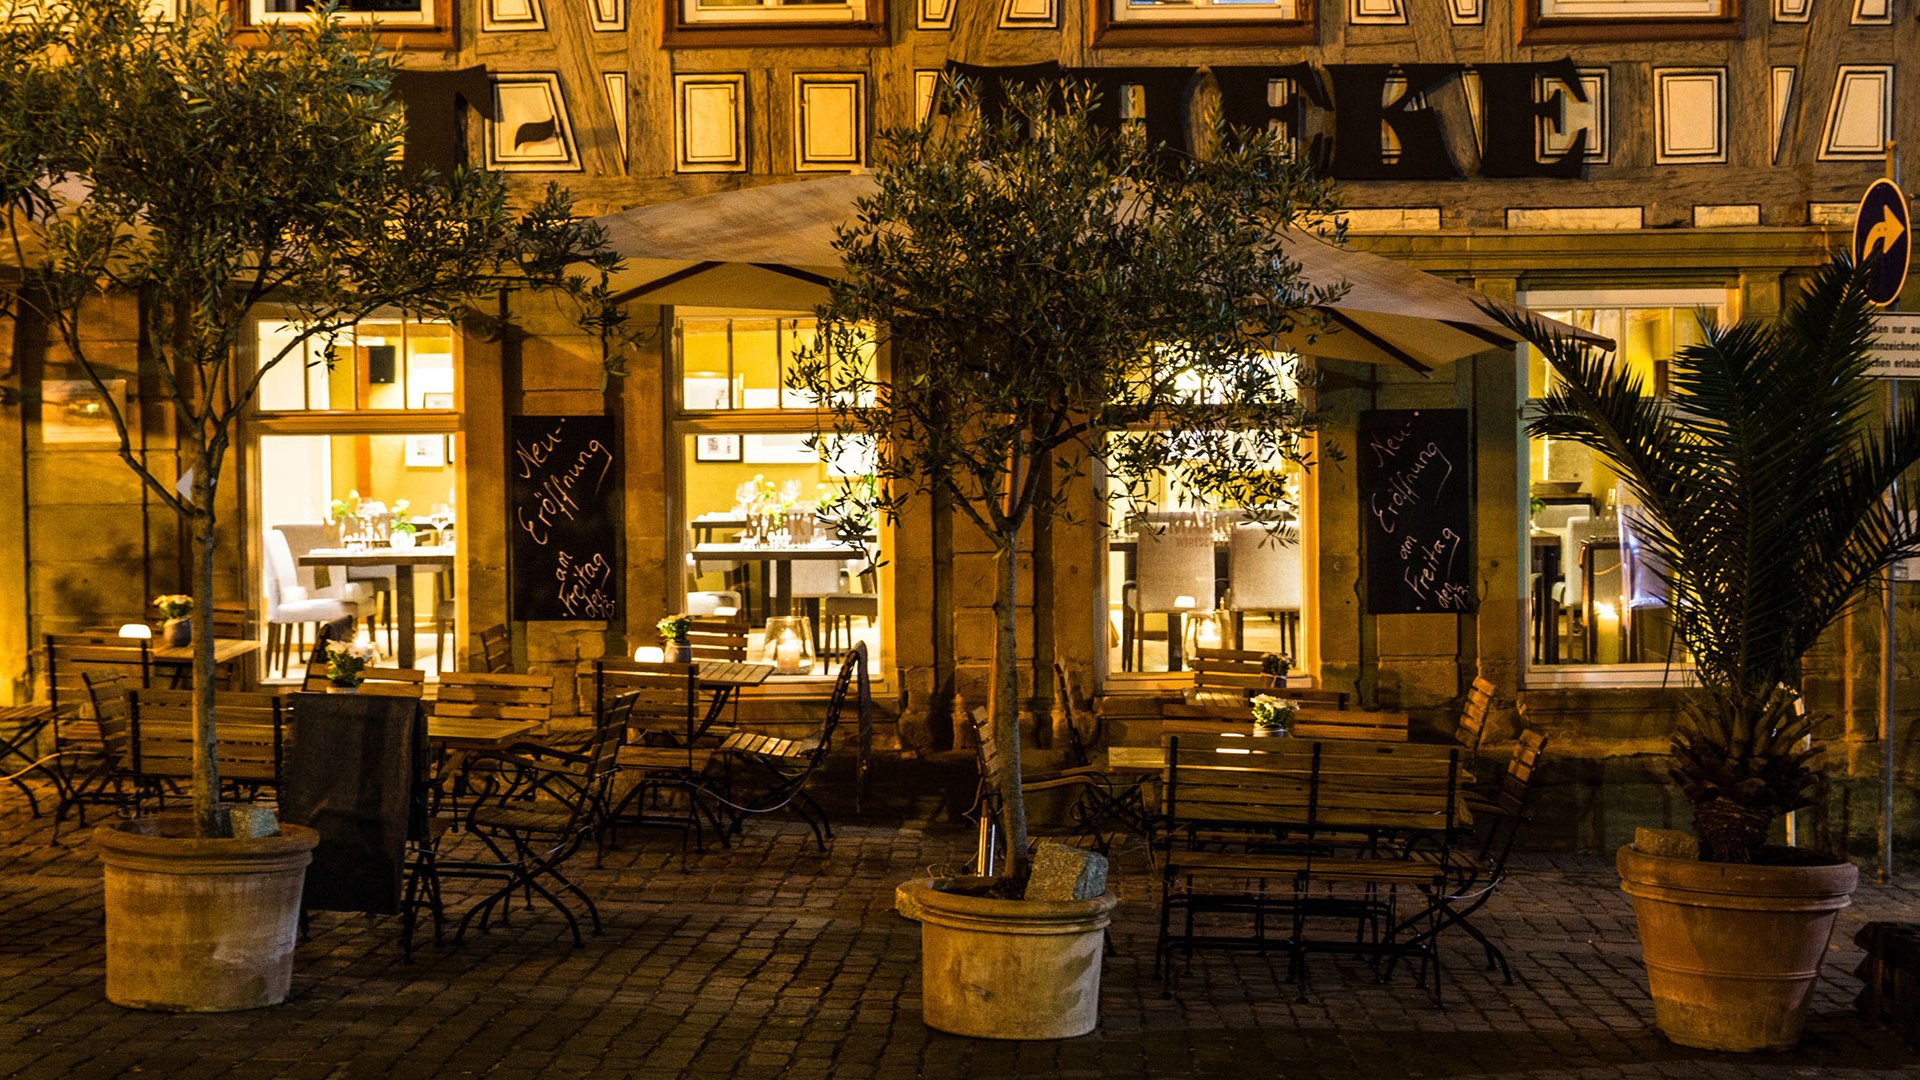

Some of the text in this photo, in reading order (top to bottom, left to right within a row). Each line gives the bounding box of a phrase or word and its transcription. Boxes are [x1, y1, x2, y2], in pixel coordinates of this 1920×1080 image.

[1892, 326, 1906, 334] nur
[517, 438, 613, 546] Eröffnung
[1371, 441, 1453, 534] Eröffnung
[746, 512, 817, 537] MARKT
[1399, 534, 1418, 561] am
[555, 550, 574, 582] am
[558, 552, 611, 616] Freitag
[1404, 527, 1461, 601] Freitag
